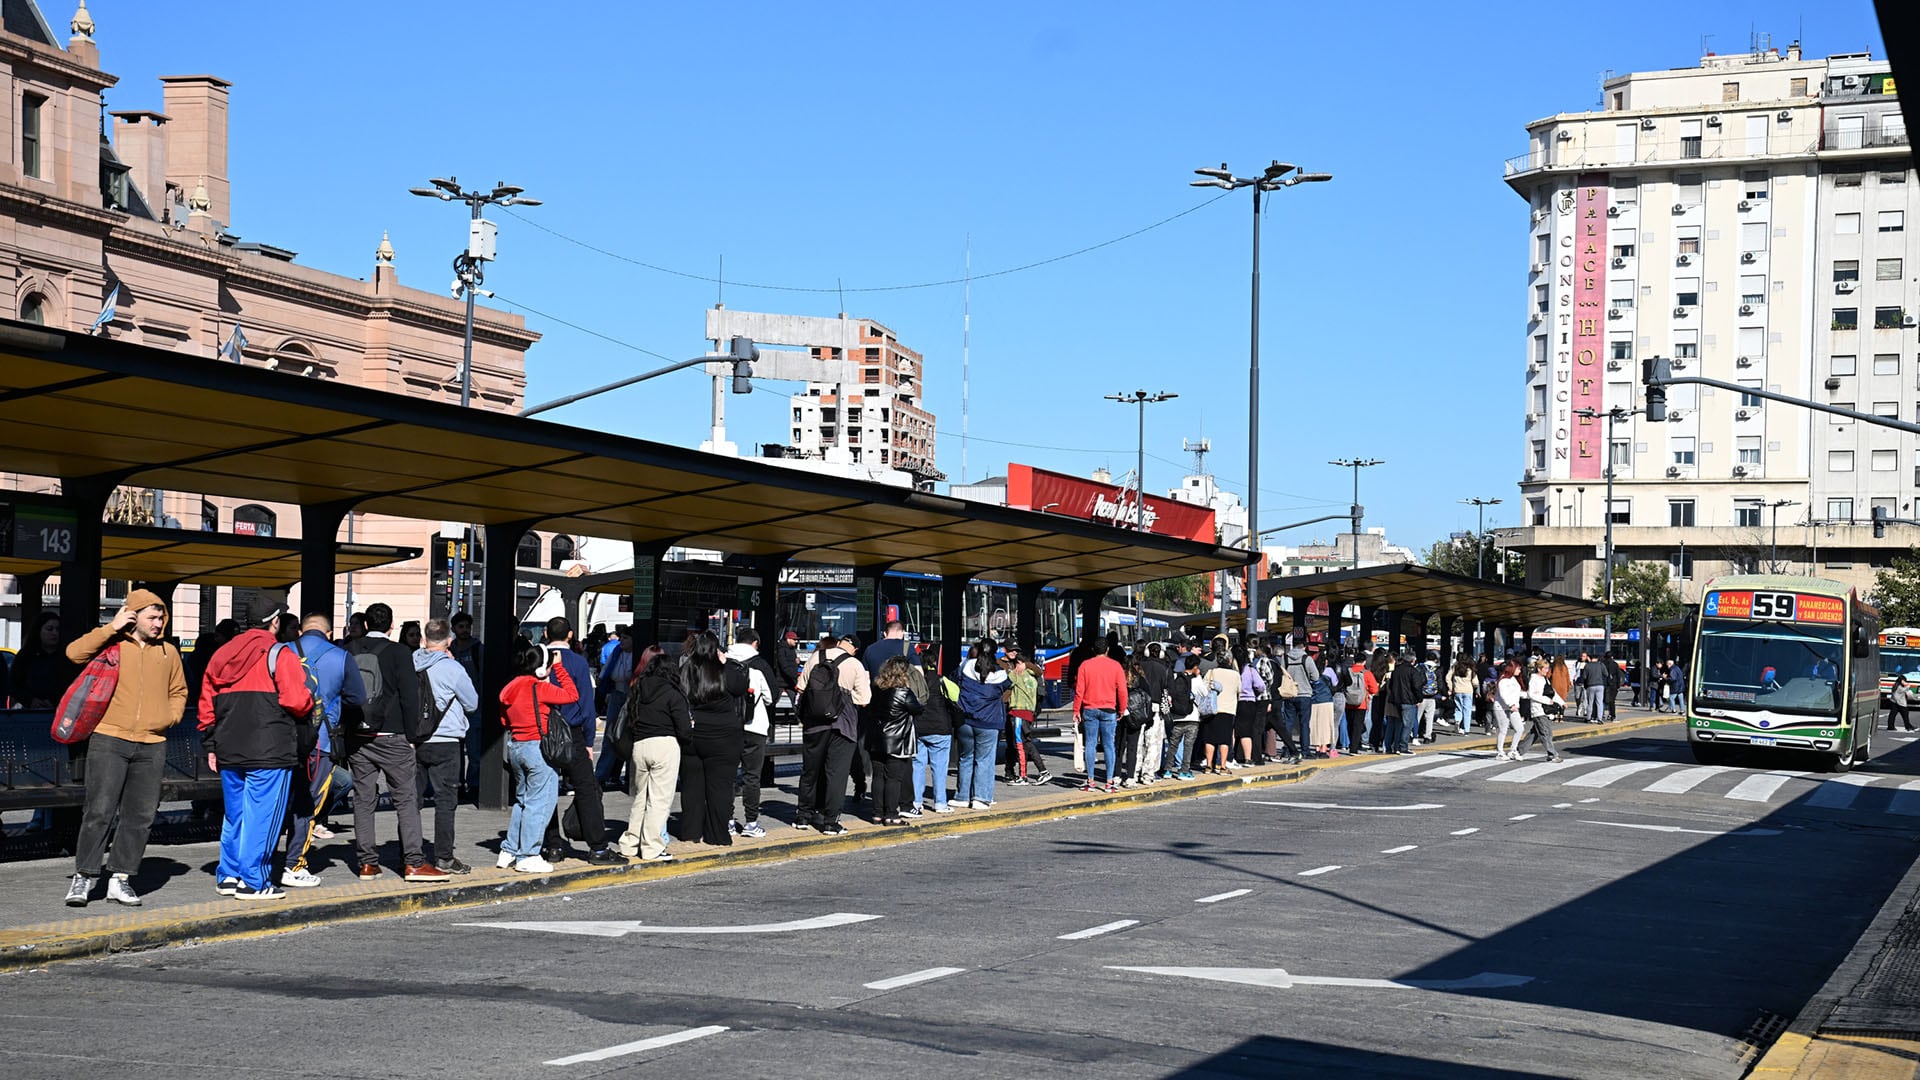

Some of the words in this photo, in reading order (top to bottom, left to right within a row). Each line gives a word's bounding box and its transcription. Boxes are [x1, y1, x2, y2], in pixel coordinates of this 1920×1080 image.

[1583, 188, 1598, 290] PALACE
[1555, 235, 1573, 460] CONSTITUCION
[1577, 319, 1597, 458] HOTEL
[40, 527, 71, 554] 143
[750, 590, 761, 607] 45
[1718, 595, 1730, 604] Est.
[1753, 593, 1794, 618] 59
[1798, 600, 1843, 611] PANAMERICANA
[1717, 606, 1750, 616] CONSTITUCION
[1803, 610, 1815, 619] SAN
[1816, 611, 1843, 622] LORENZO
[1886, 636, 1906, 646] 59
